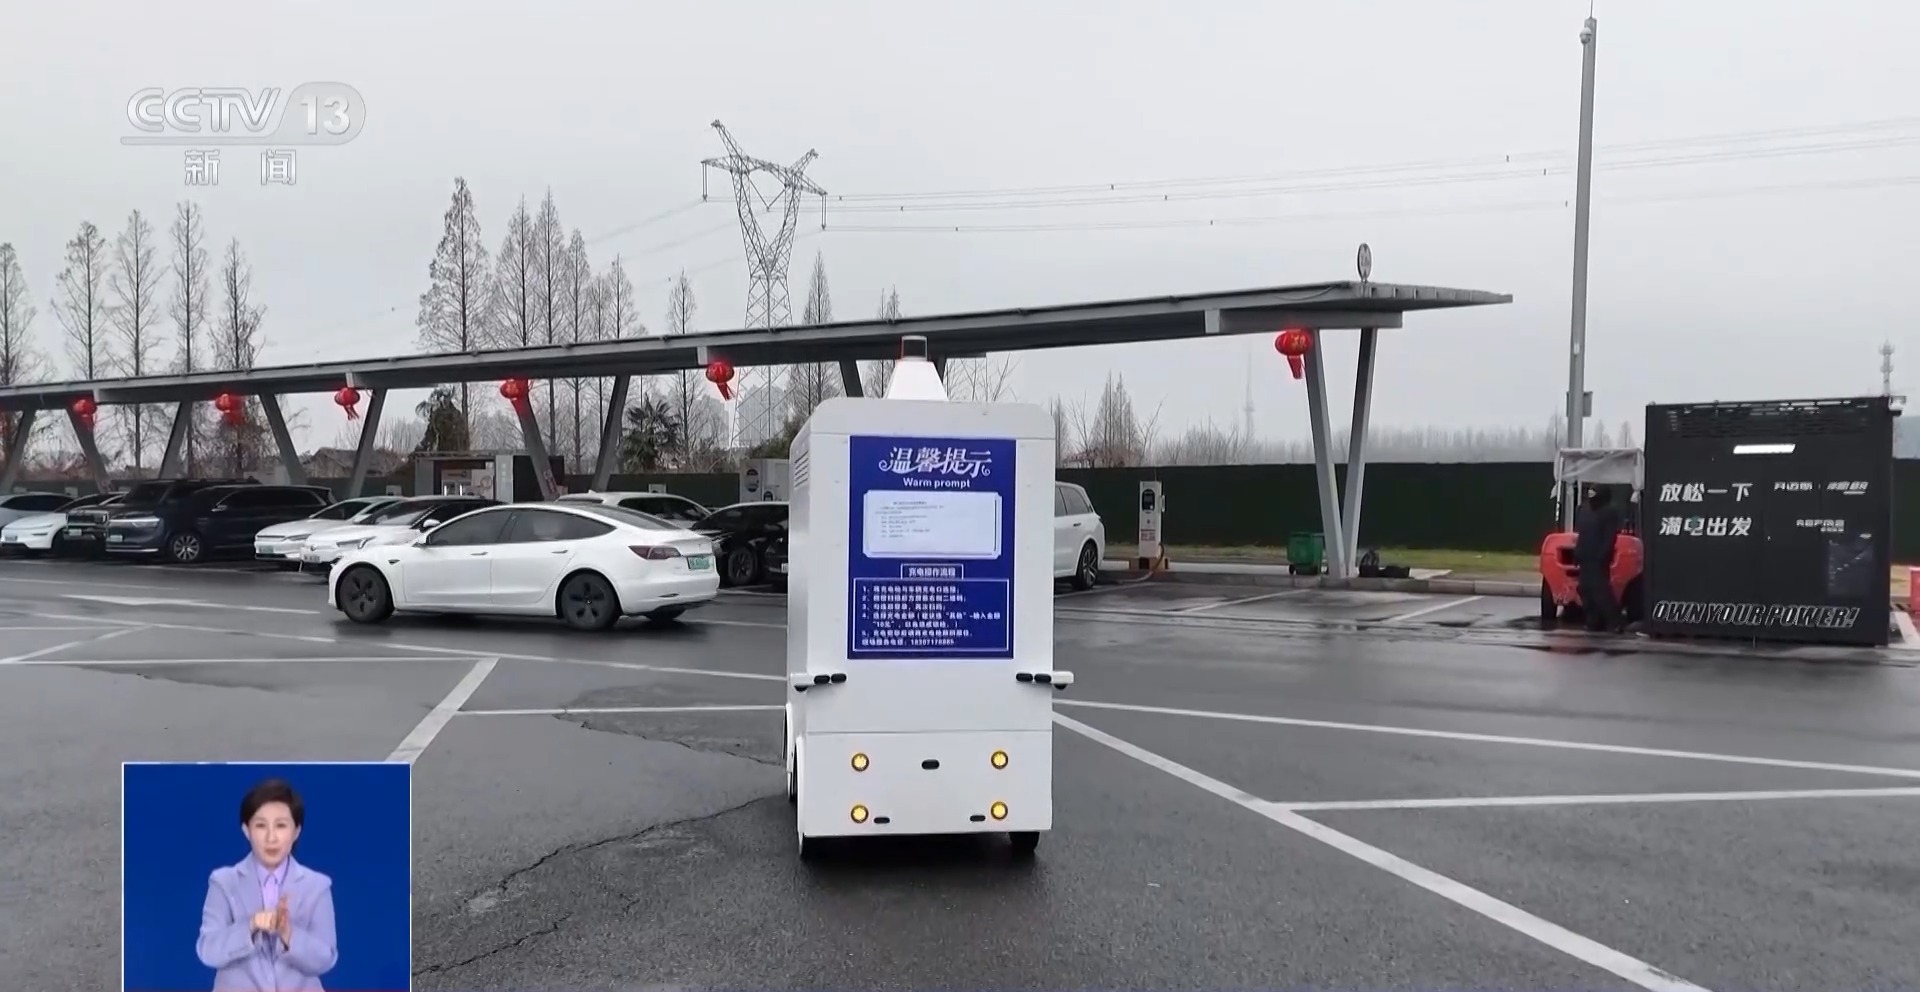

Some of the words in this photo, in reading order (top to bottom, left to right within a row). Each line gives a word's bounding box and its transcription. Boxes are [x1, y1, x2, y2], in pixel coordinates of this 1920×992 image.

[878, 446, 993, 479] 温馨提示
[903, 478, 932, 487] Warm
[934, 479, 971, 489] prompt
[1659, 482, 1754, 502] 放松一下
[1659, 516, 1752, 536] 满电出发
[1652, 600, 1706, 623] OWN
[1705, 603, 1766, 626] YOUR
[1765, 604, 1860, 628] POWER!
